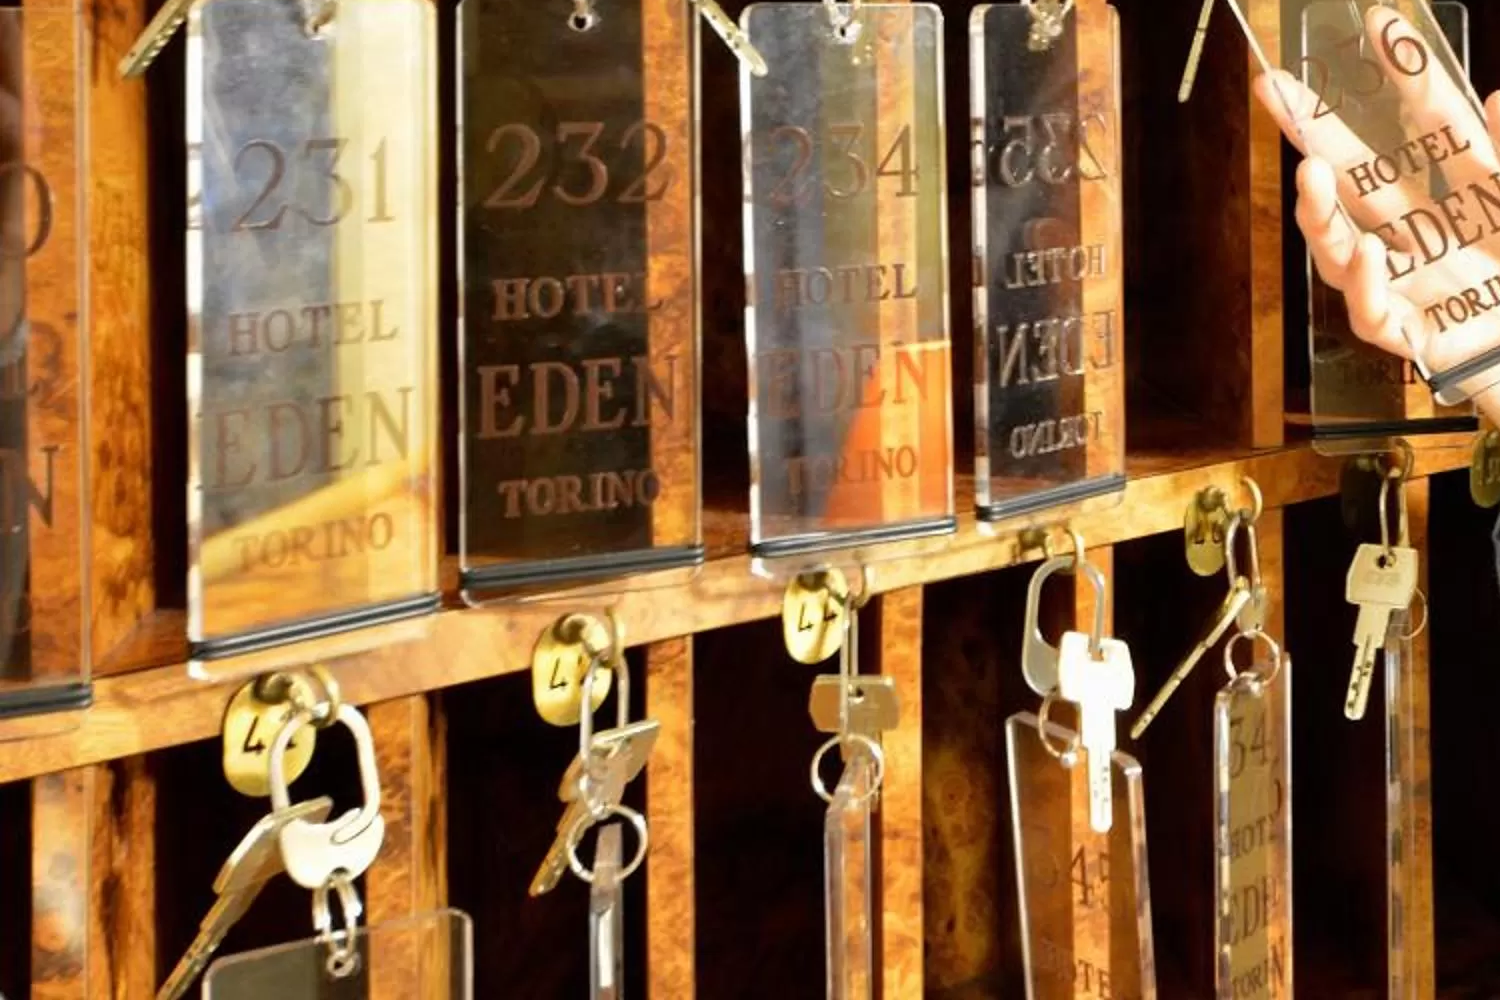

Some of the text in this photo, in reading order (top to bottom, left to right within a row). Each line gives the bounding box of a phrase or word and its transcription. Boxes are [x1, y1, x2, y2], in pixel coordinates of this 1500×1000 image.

[1288, 17, 1428, 121] 236
[229, 136, 396, 233] 231
[483, 120, 674, 209] 232
[768, 122, 920, 205] 234
[1346, 124, 1472, 198] HOTEL
[491, 271, 665, 321] HOTEL
[772, 262, 919, 306] HOTEL
[227, 299, 399, 356] HOTEL
[476, 354, 679, 440] EDEN
[764, 340, 932, 418] EDEN
[212, 386, 415, 494] EDEN
[497, 468, 661, 518] TORINO
[232, 512, 394, 571] TORINO
